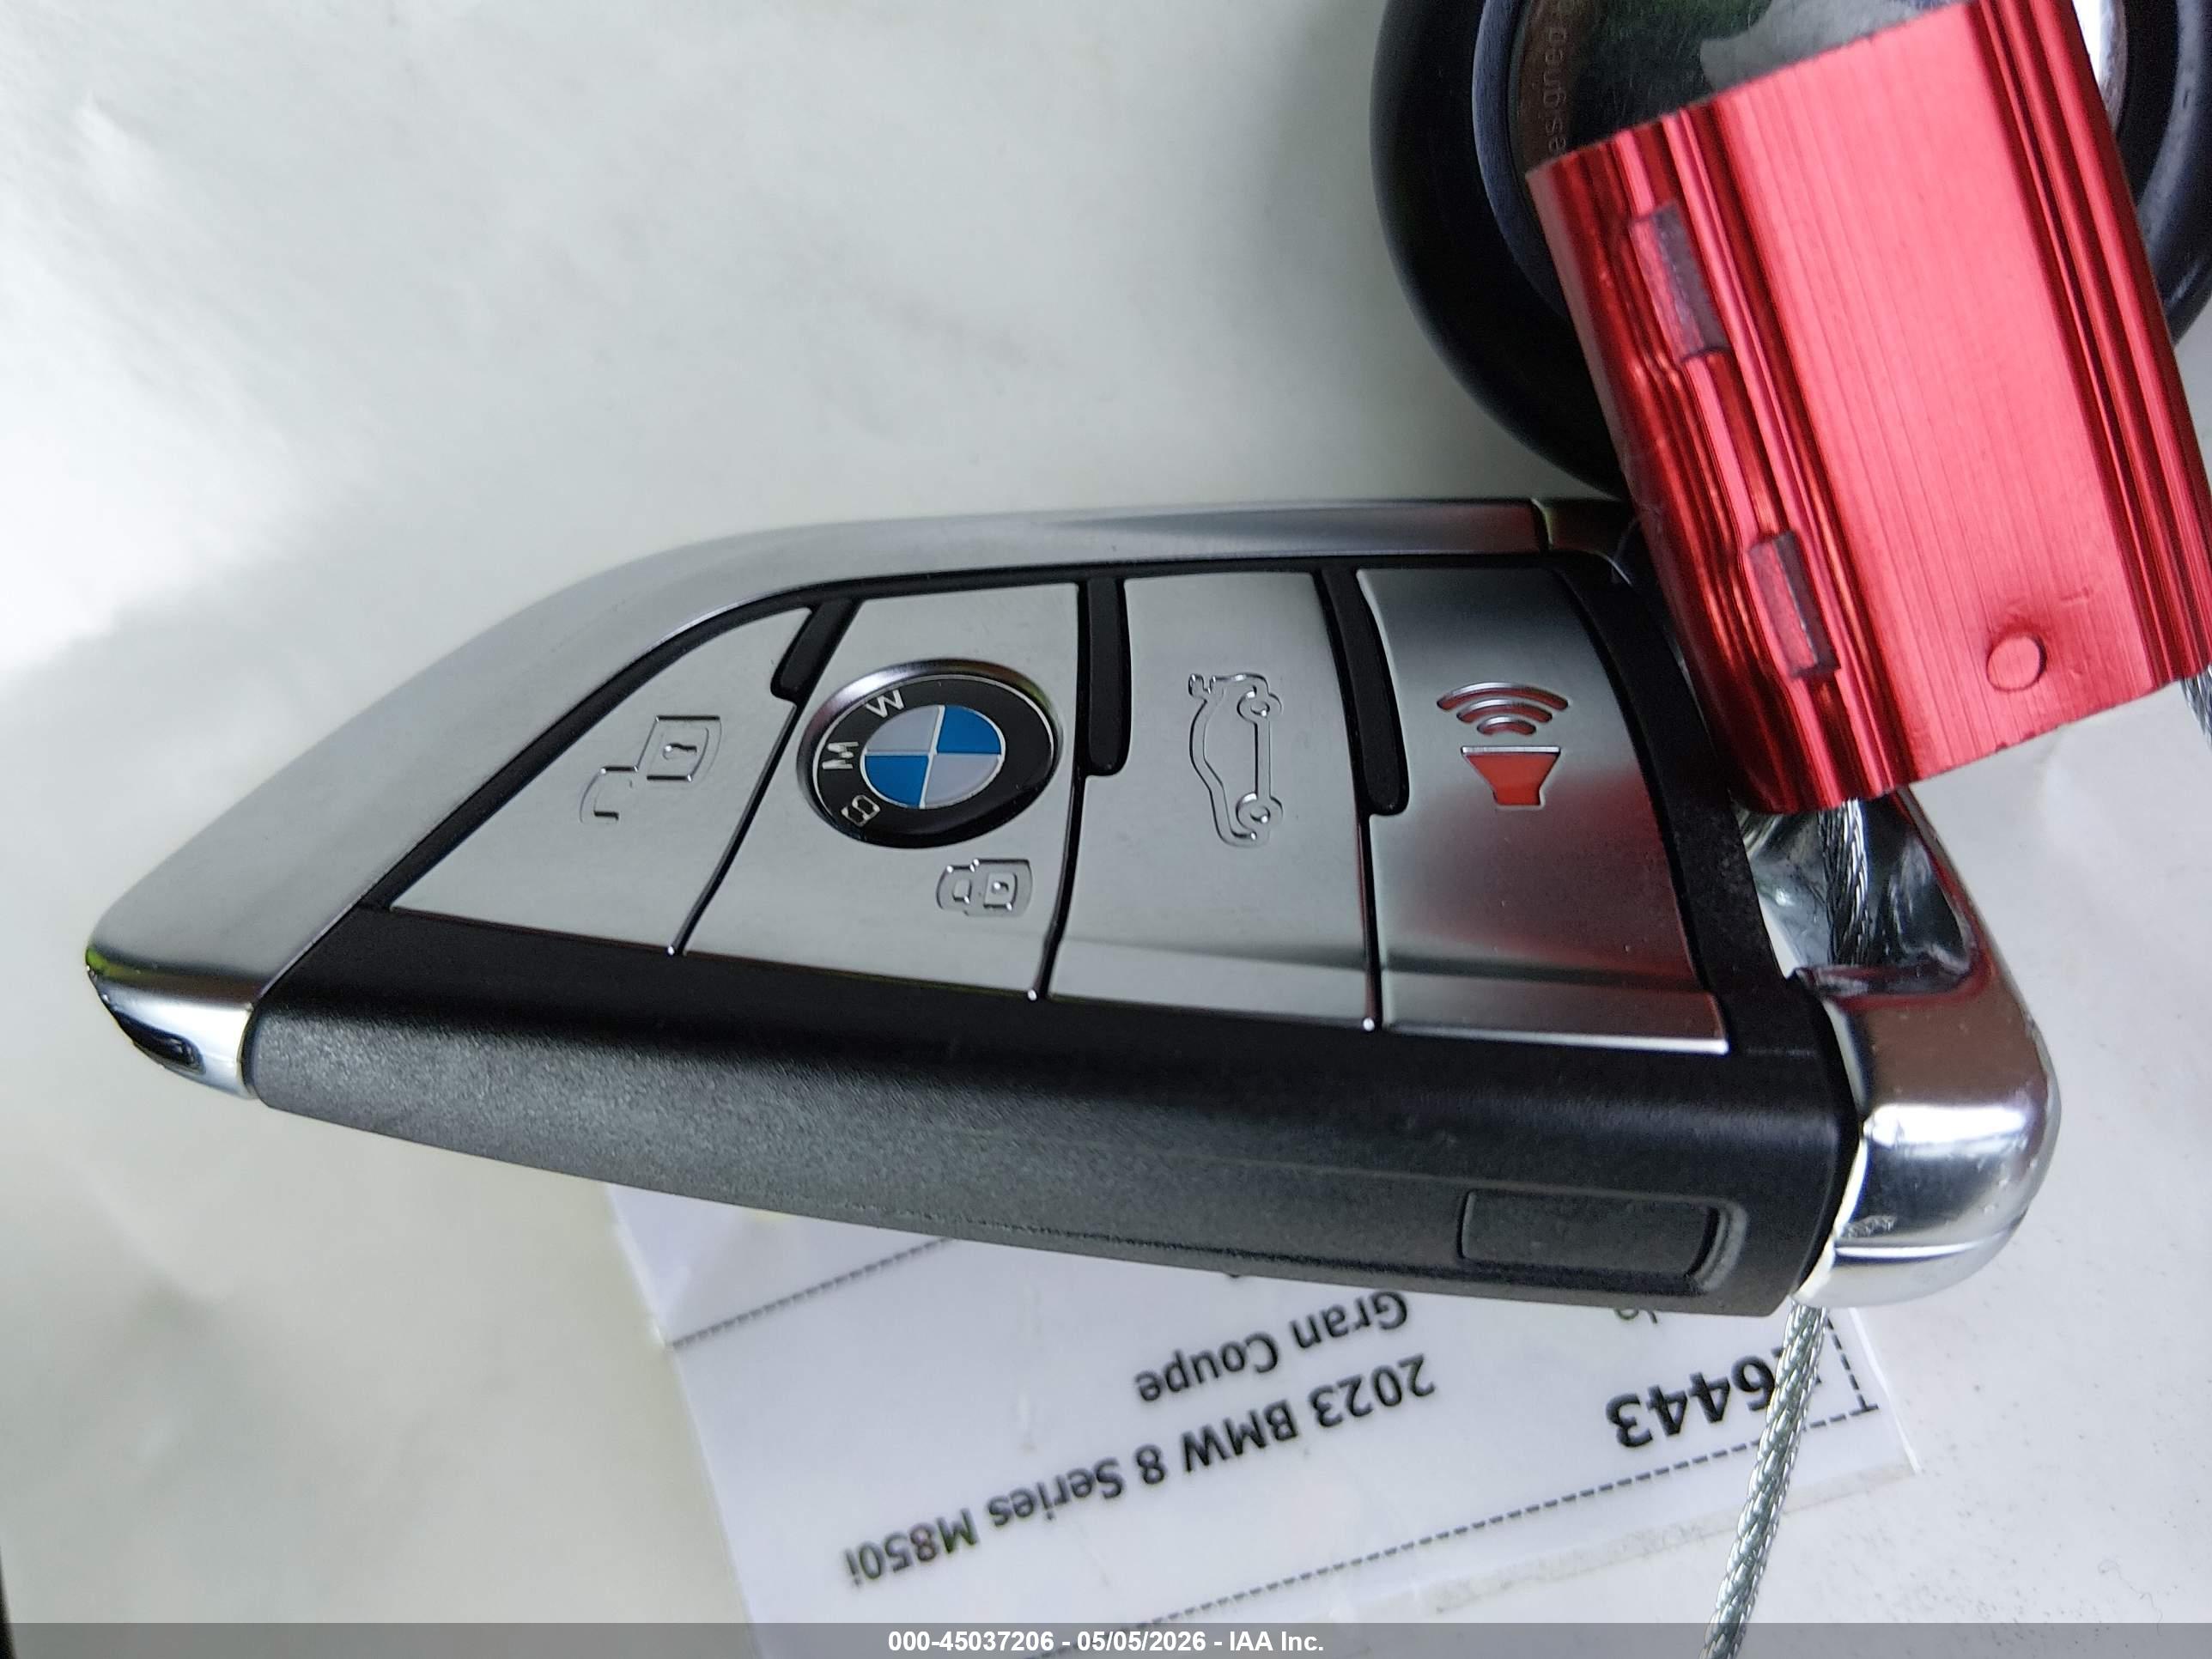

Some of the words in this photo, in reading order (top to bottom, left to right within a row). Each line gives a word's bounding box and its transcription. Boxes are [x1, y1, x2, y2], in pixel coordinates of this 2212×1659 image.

[822, 689, 905, 827] BMW
[1289, 1290, 1408, 1349] Gran
[1133, 1332, 1279, 1401] Coupe
[1307, 1352, 1436, 1428] 2023
[1605, 1346, 1821, 1448] 6443
[1133, 1443, 1168, 1486] 8
[1180, 1399, 1298, 1473] BMW
[987, 1457, 1127, 1528] Series
[844, 1507, 981, 1586] M850i
